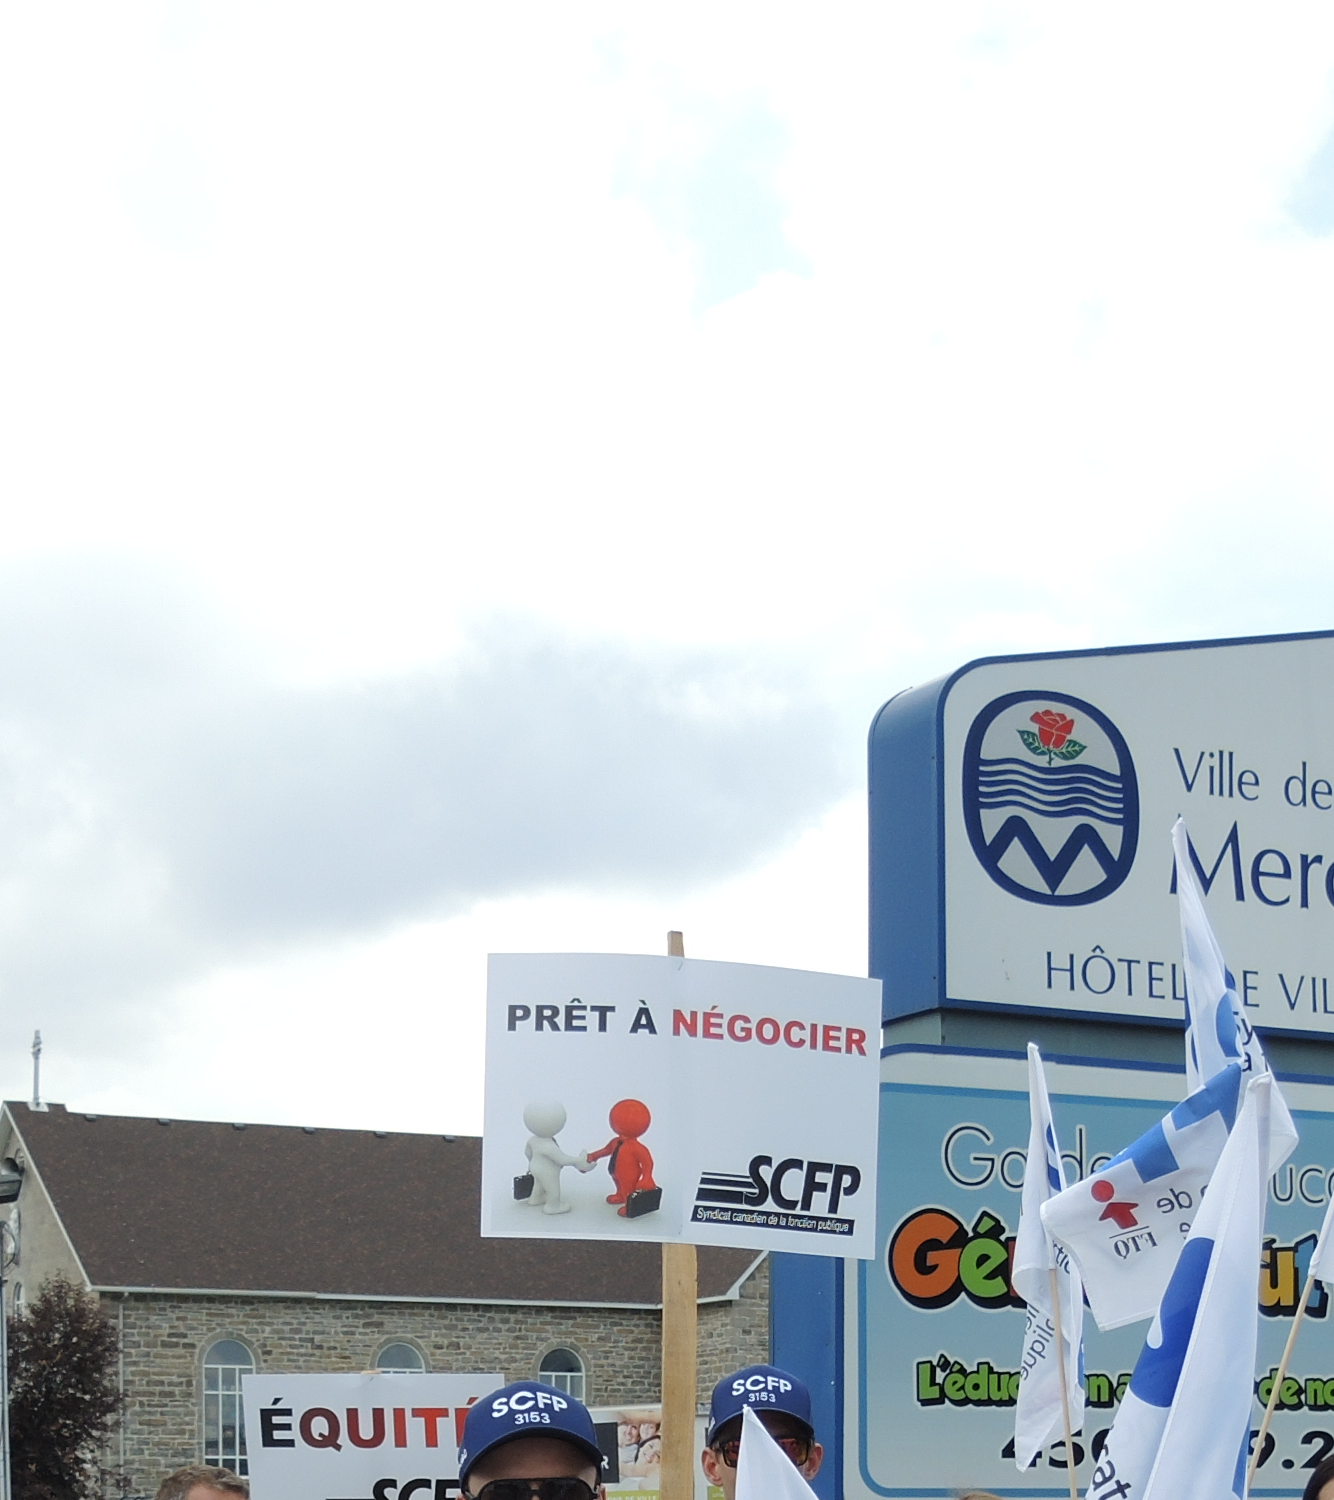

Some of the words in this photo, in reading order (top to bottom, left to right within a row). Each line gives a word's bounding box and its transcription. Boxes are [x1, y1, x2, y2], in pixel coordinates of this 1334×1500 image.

[1173, 747, 1260, 801] Ville
[1283, 761, 1334, 811] de
[1046, 946, 1185, 1000] HÔTEL
[507, 998, 616, 1033] PRÊT
[629, 1000, 658, 1035] À
[672, 1005, 867, 1057] NÉGOCIER
[743, 1154, 861, 1214] SCFP
[491, 1391, 568, 1418] SCFP
[732, 1375, 792, 1396] SCFP
[748, 1391, 776, 1403] 3153
[514, 1412, 551, 1425] 3153
